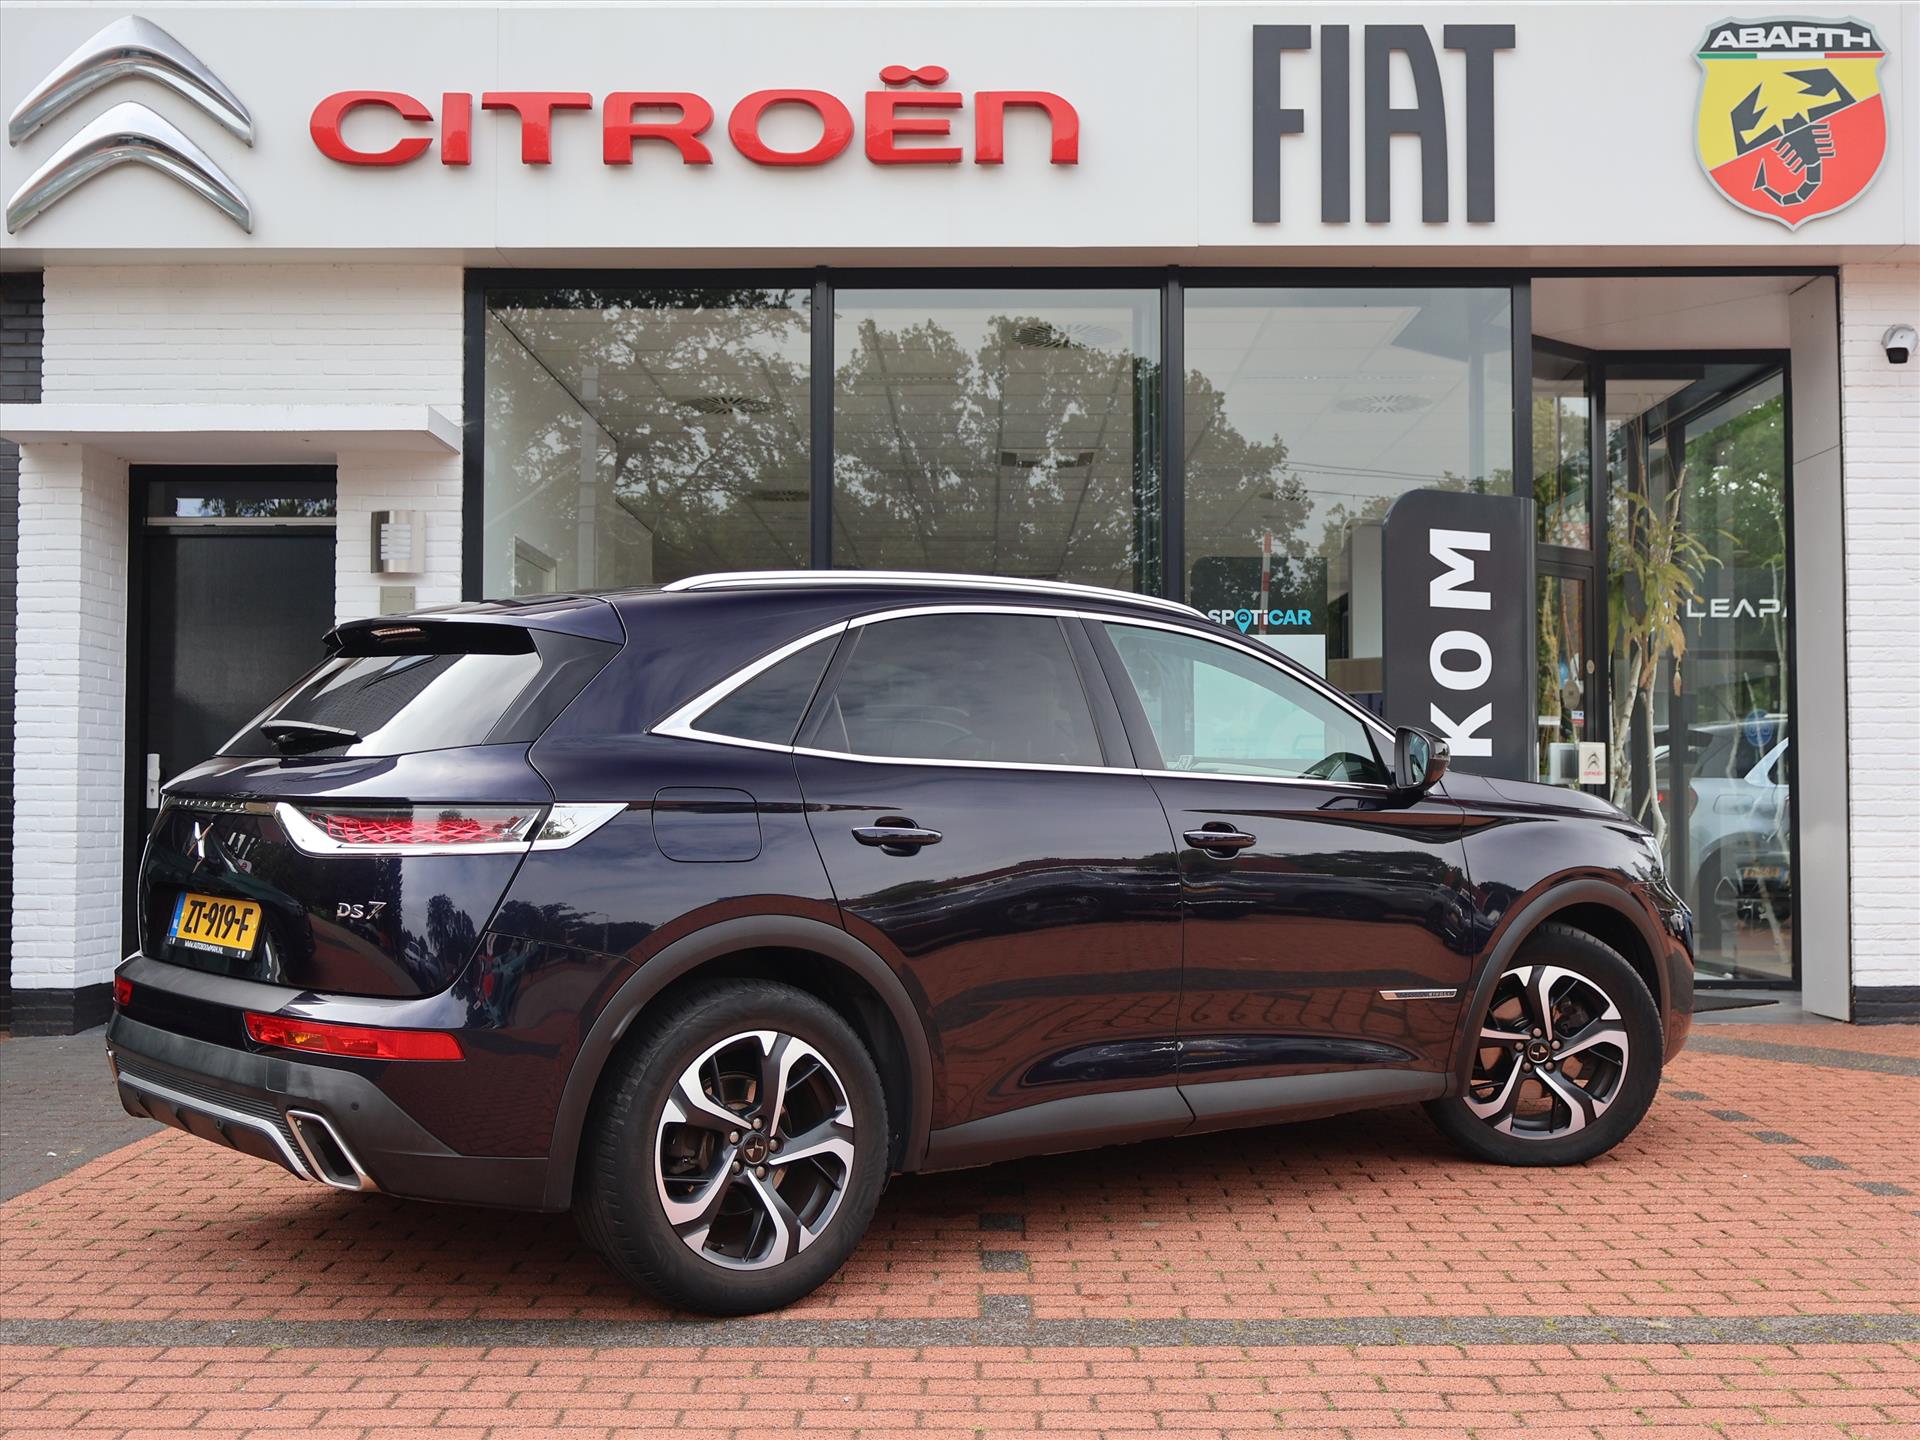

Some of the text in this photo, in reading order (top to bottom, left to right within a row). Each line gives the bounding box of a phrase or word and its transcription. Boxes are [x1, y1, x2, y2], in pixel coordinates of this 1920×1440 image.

[1710, 25, 1872, 49] ABARTH
[310, 65, 1080, 168] CITROËN
[1252, 24, 1516, 224] FIAT
[1428, 528, 1493, 758] KOM
[1686, 598, 1788, 618] LEAP
[183, 900, 254, 942] ZT-919-F
